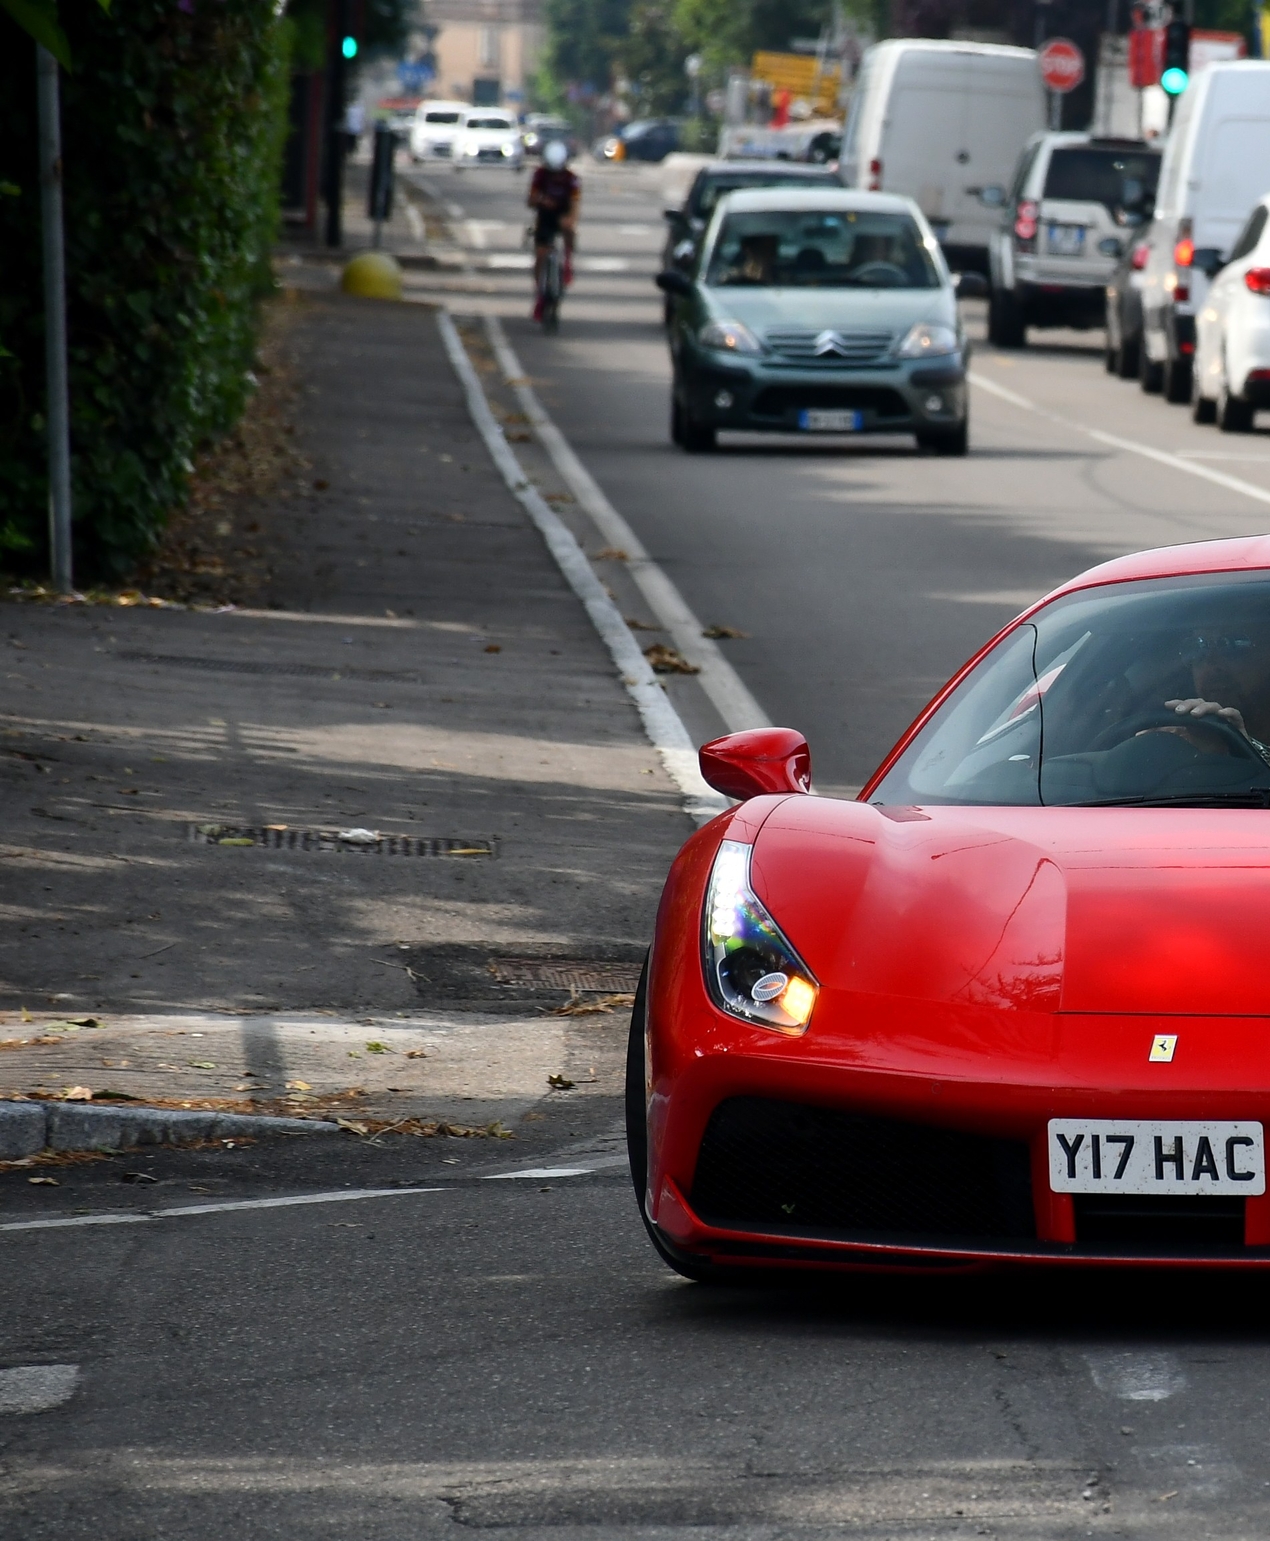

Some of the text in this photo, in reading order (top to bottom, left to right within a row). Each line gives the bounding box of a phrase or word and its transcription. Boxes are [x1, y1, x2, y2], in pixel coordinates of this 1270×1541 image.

[1042, 56, 1082, 75] STOP
[1056, 1133, 1256, 1181] Y17 HAC
